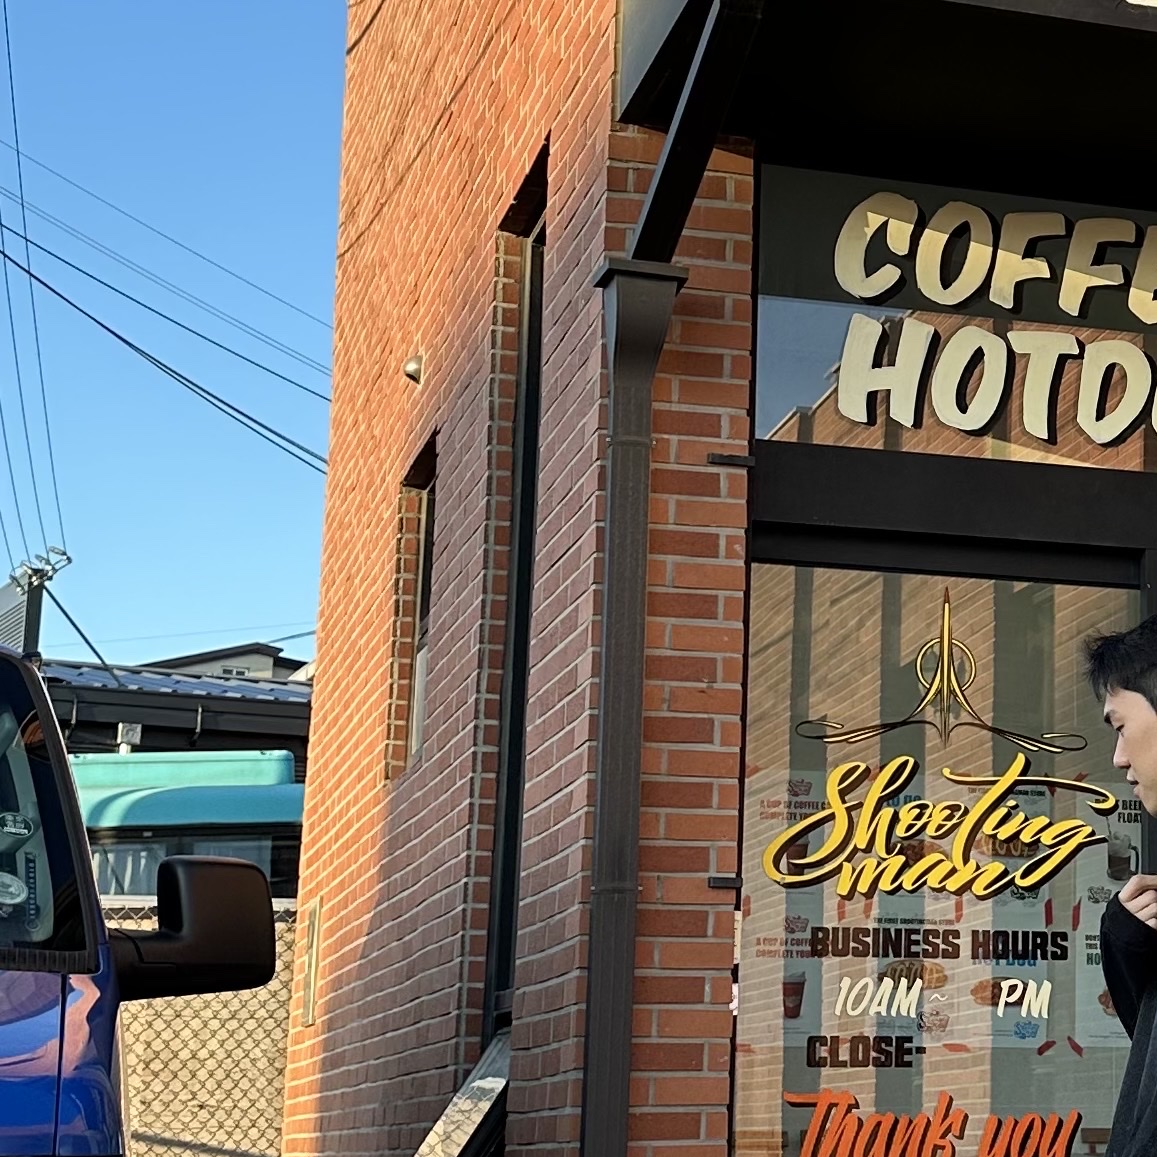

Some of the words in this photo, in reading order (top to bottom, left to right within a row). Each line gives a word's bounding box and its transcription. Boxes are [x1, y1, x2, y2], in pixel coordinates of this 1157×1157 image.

[762, 752, 1118, 888] Shooting
[836, 853, 1012, 901] man
[810, 926, 961, 959] BUSINESS
[970, 929, 1069, 961] HOURS
[1086, 952, 1101, 966] HO
[996, 979, 1052, 1019] PM
